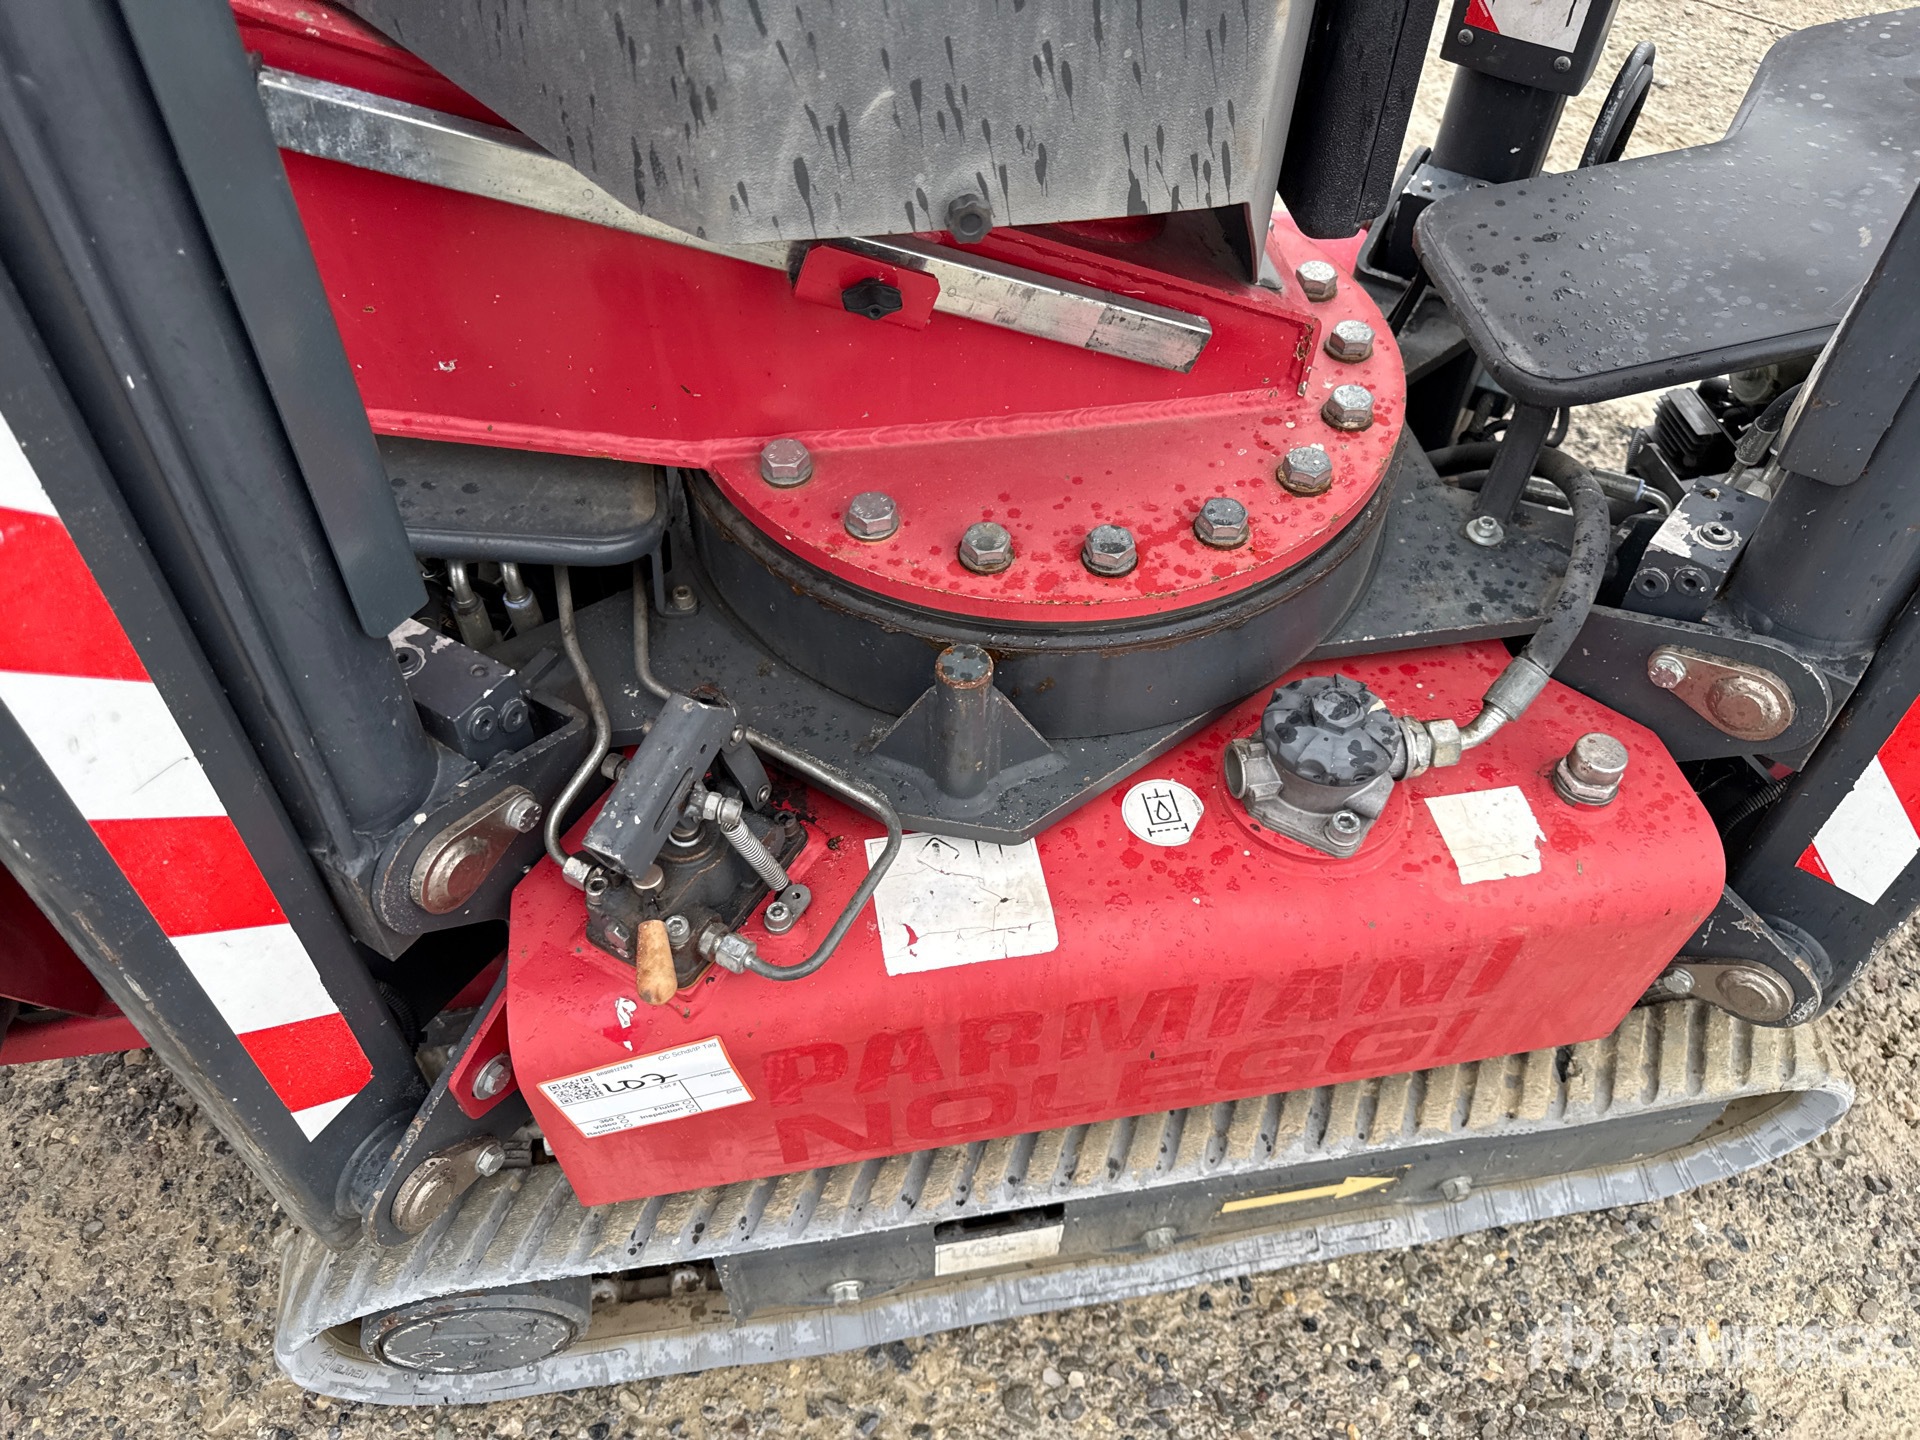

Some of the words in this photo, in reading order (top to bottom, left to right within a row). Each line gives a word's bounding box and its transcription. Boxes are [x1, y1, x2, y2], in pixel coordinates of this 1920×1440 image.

[761, 935, 1525, 1101] PARMIANI
[658, 1053, 671, 1061] OC
[703, 1042, 717, 1050] Tag
[775, 1009, 1484, 1165] NOLEGGI
[639, 1107, 684, 1120] Inspection
[653, 1103, 680, 1112] Fluids
[593, 1121, 618, 1130] Video
